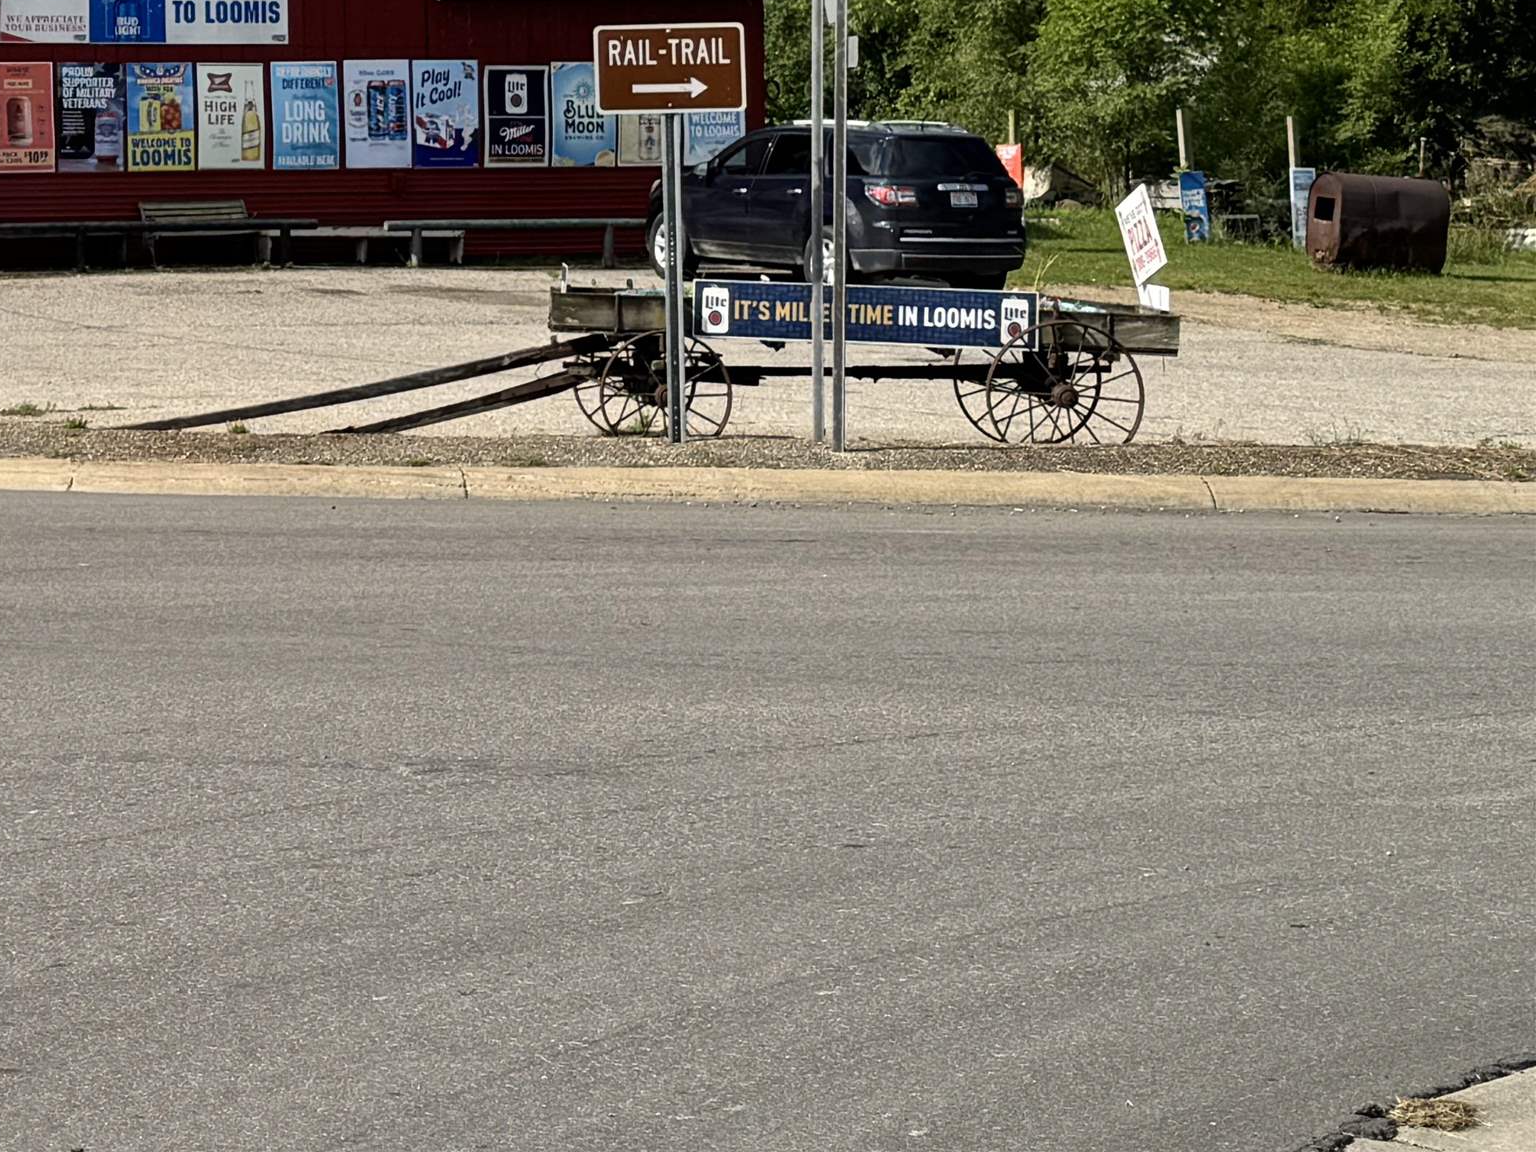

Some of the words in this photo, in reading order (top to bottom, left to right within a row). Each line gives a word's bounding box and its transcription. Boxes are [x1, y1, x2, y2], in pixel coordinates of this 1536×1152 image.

[172, 0, 196, 24] TO
[204, 0, 281, 24] LOOMIS
[6, 14, 23, 24] WE
[24, 15, 85, 24] APPRECIATE
[116, 16, 139, 26] BUD
[5, 23, 32, 32] YOUR
[114, 25, 142, 36] LIGHT
[608, 37, 731, 66] RAIL-TRAIL
[62, 66, 94, 78] PROUD
[421, 68, 451, 88] Play
[62, 77, 115, 88] SUPPORTER
[282, 77, 327, 90] DIFFERENT
[62, 87, 74, 98] OF
[75, 87, 117, 99] MILITARY
[415, 92, 426, 109] It
[429, 81, 462, 105] Cool!
[62, 98, 108, 109] VETERANS
[204, 100, 237, 112] HIGH
[284, 100, 326, 121] LONG
[207, 113, 235, 125] LIFE
[691, 112, 737, 124] WELCOME
[282, 121, 331, 144] DRINK
[499, 123, 536, 142] Miller
[564, 119, 605, 134] MOON
[690, 124, 703, 137] TO
[705, 124, 741, 137] LOOMIS
[131, 138, 173, 148] WELCOME
[180, 137, 192, 148] TO
[491, 144, 503, 155] IN
[505, 143, 544, 156] LOOMIS
[131, 149, 192, 167] LOOMIS
[1127, 215, 1154, 255] PIZZA
[705, 294, 728, 308] Lite
[733, 299, 771, 321] IT'S
[775, 300, 836, 323] MILE
[849, 304, 893, 325] TIME
[898, 306, 918, 326] IN
[923, 306, 996, 330] LOOMIS
[1003, 307, 1028, 322] Lite
